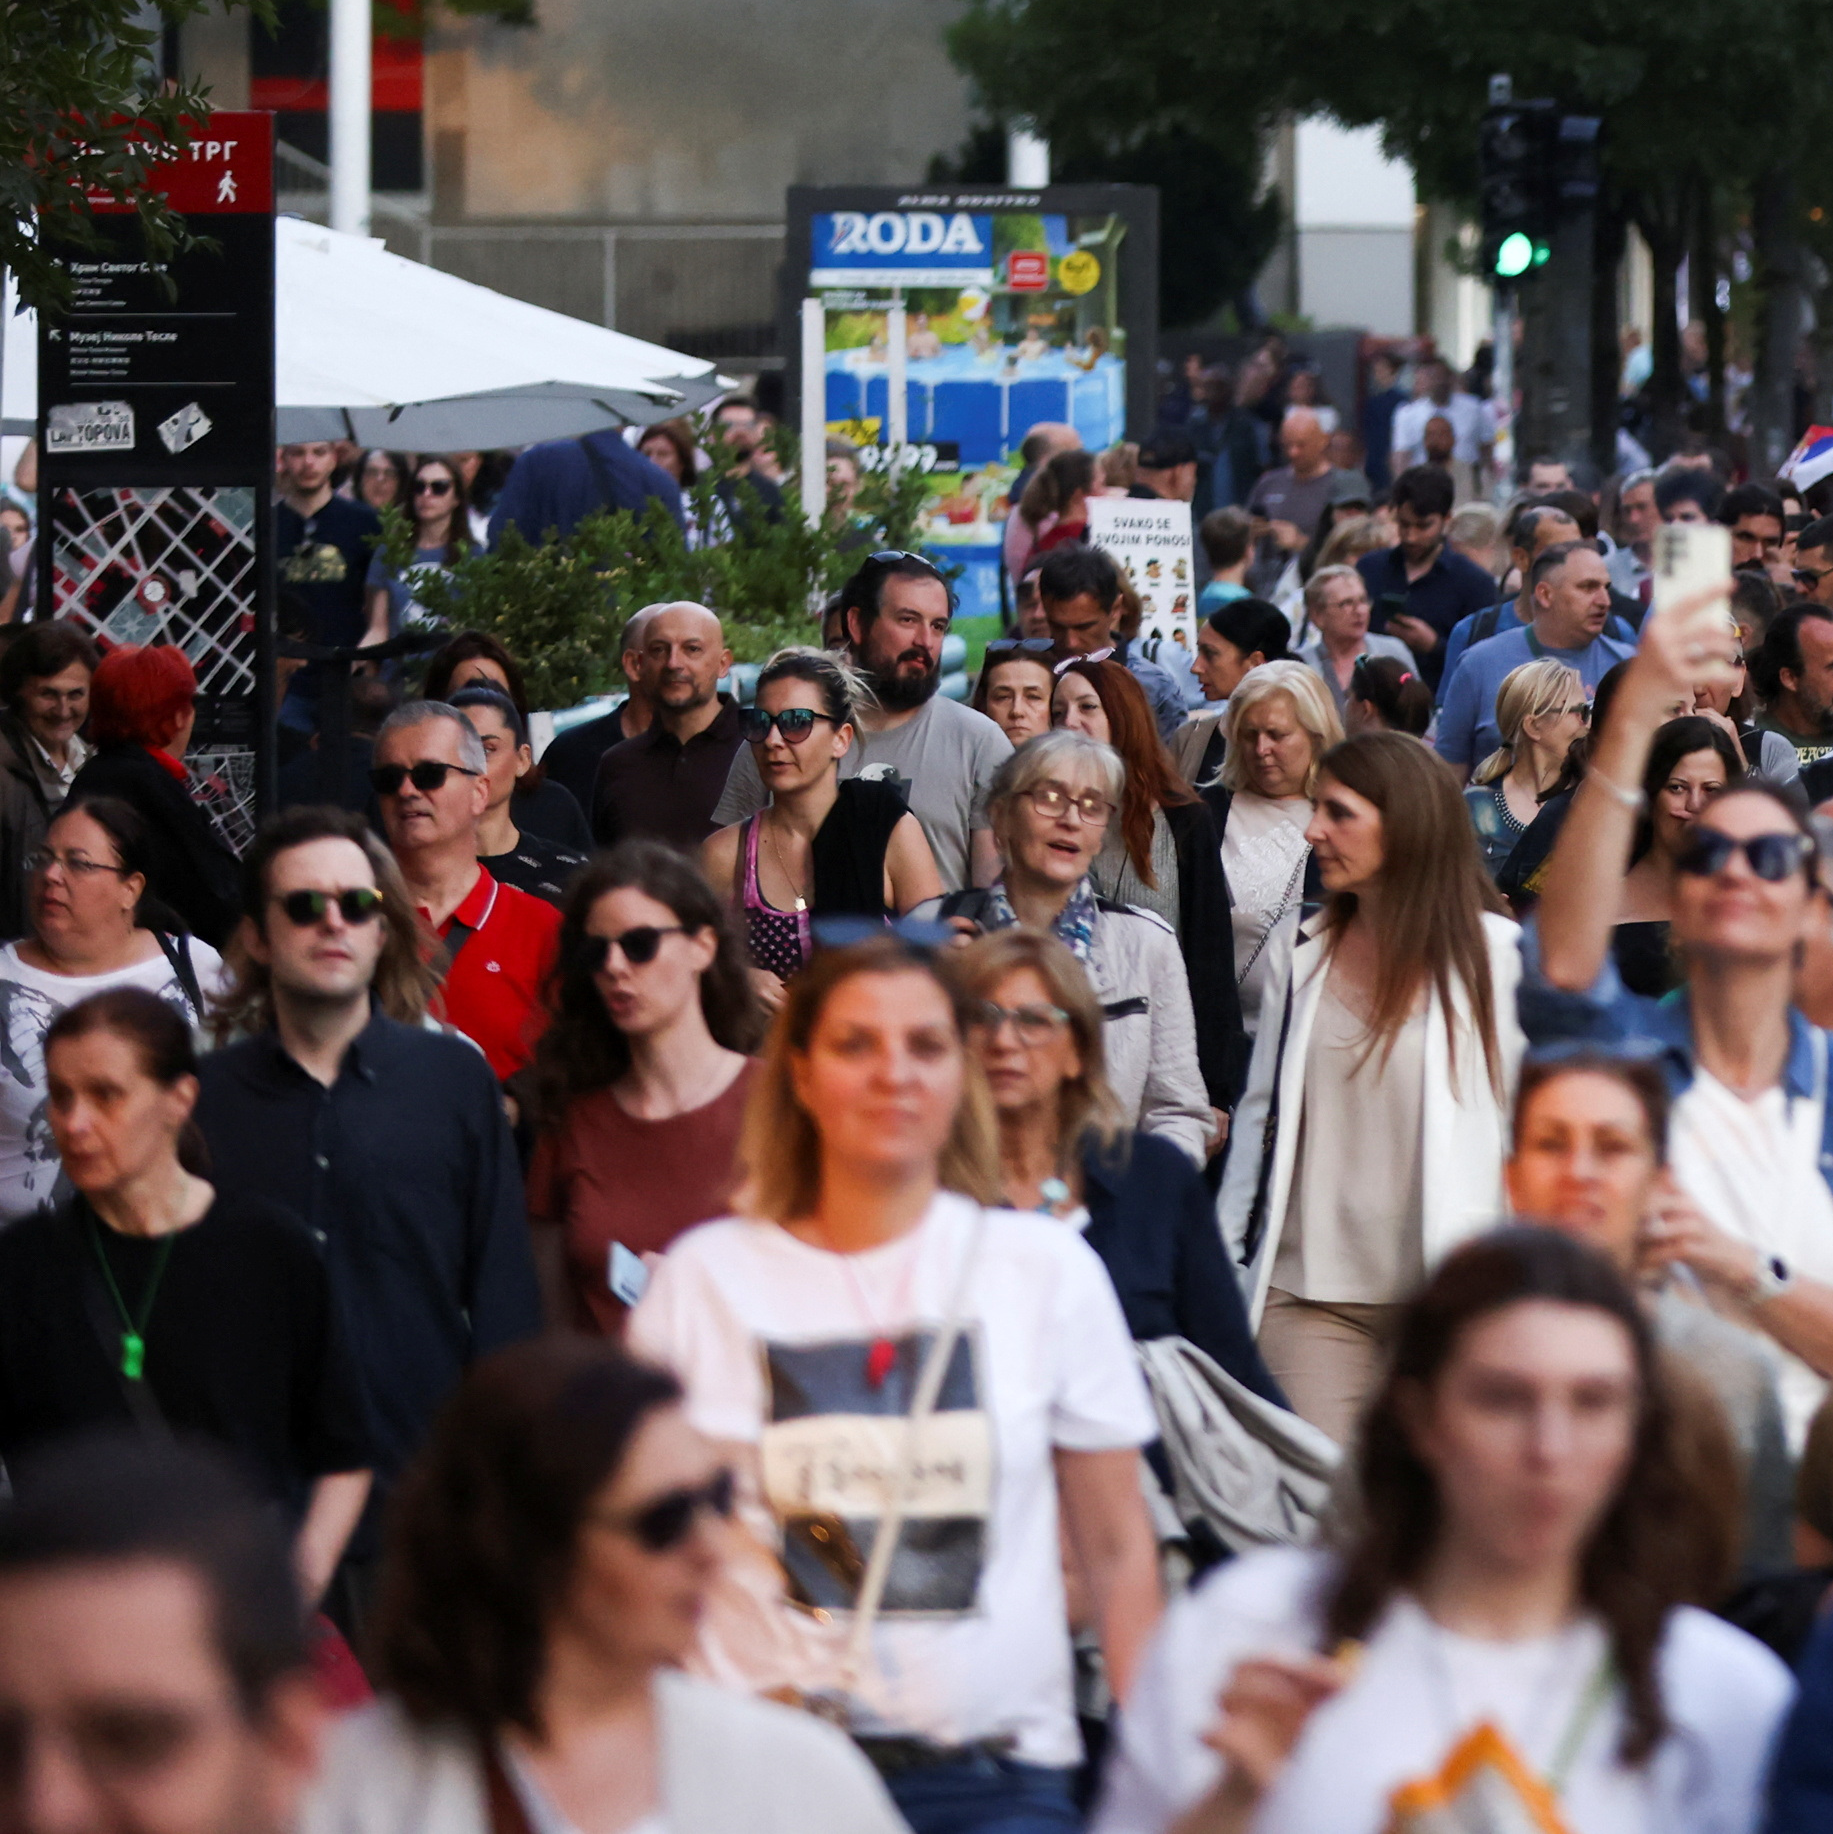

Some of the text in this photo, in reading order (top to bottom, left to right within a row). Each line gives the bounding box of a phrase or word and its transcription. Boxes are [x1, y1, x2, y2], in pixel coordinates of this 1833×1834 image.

[189, 141, 238, 162] ТРГ
[832, 212, 985, 255] RODA
[1157, 518, 1171, 529] SE
